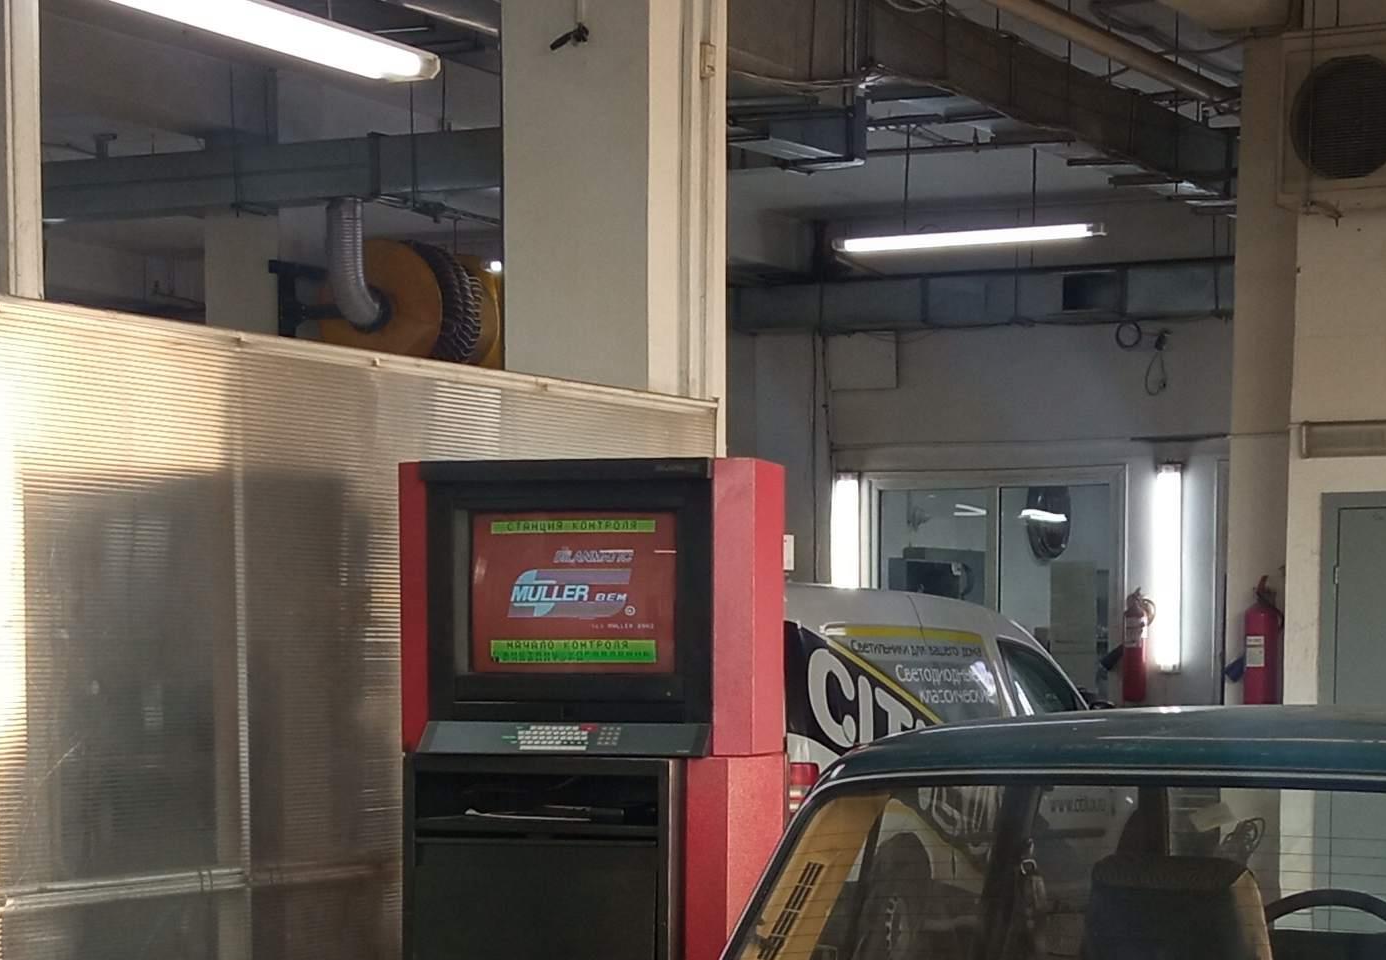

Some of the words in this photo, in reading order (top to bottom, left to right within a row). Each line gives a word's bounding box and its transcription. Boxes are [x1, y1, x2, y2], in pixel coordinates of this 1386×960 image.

[506, 520, 564, 532] СТАНЦИЯ
[572, 520, 638, 531] КОНТРОЛЯ
[510, 584, 590, 602] MULLER
[506, 640, 555, 651] НАЧАЛО
[807, 647, 926, 748] CIT
